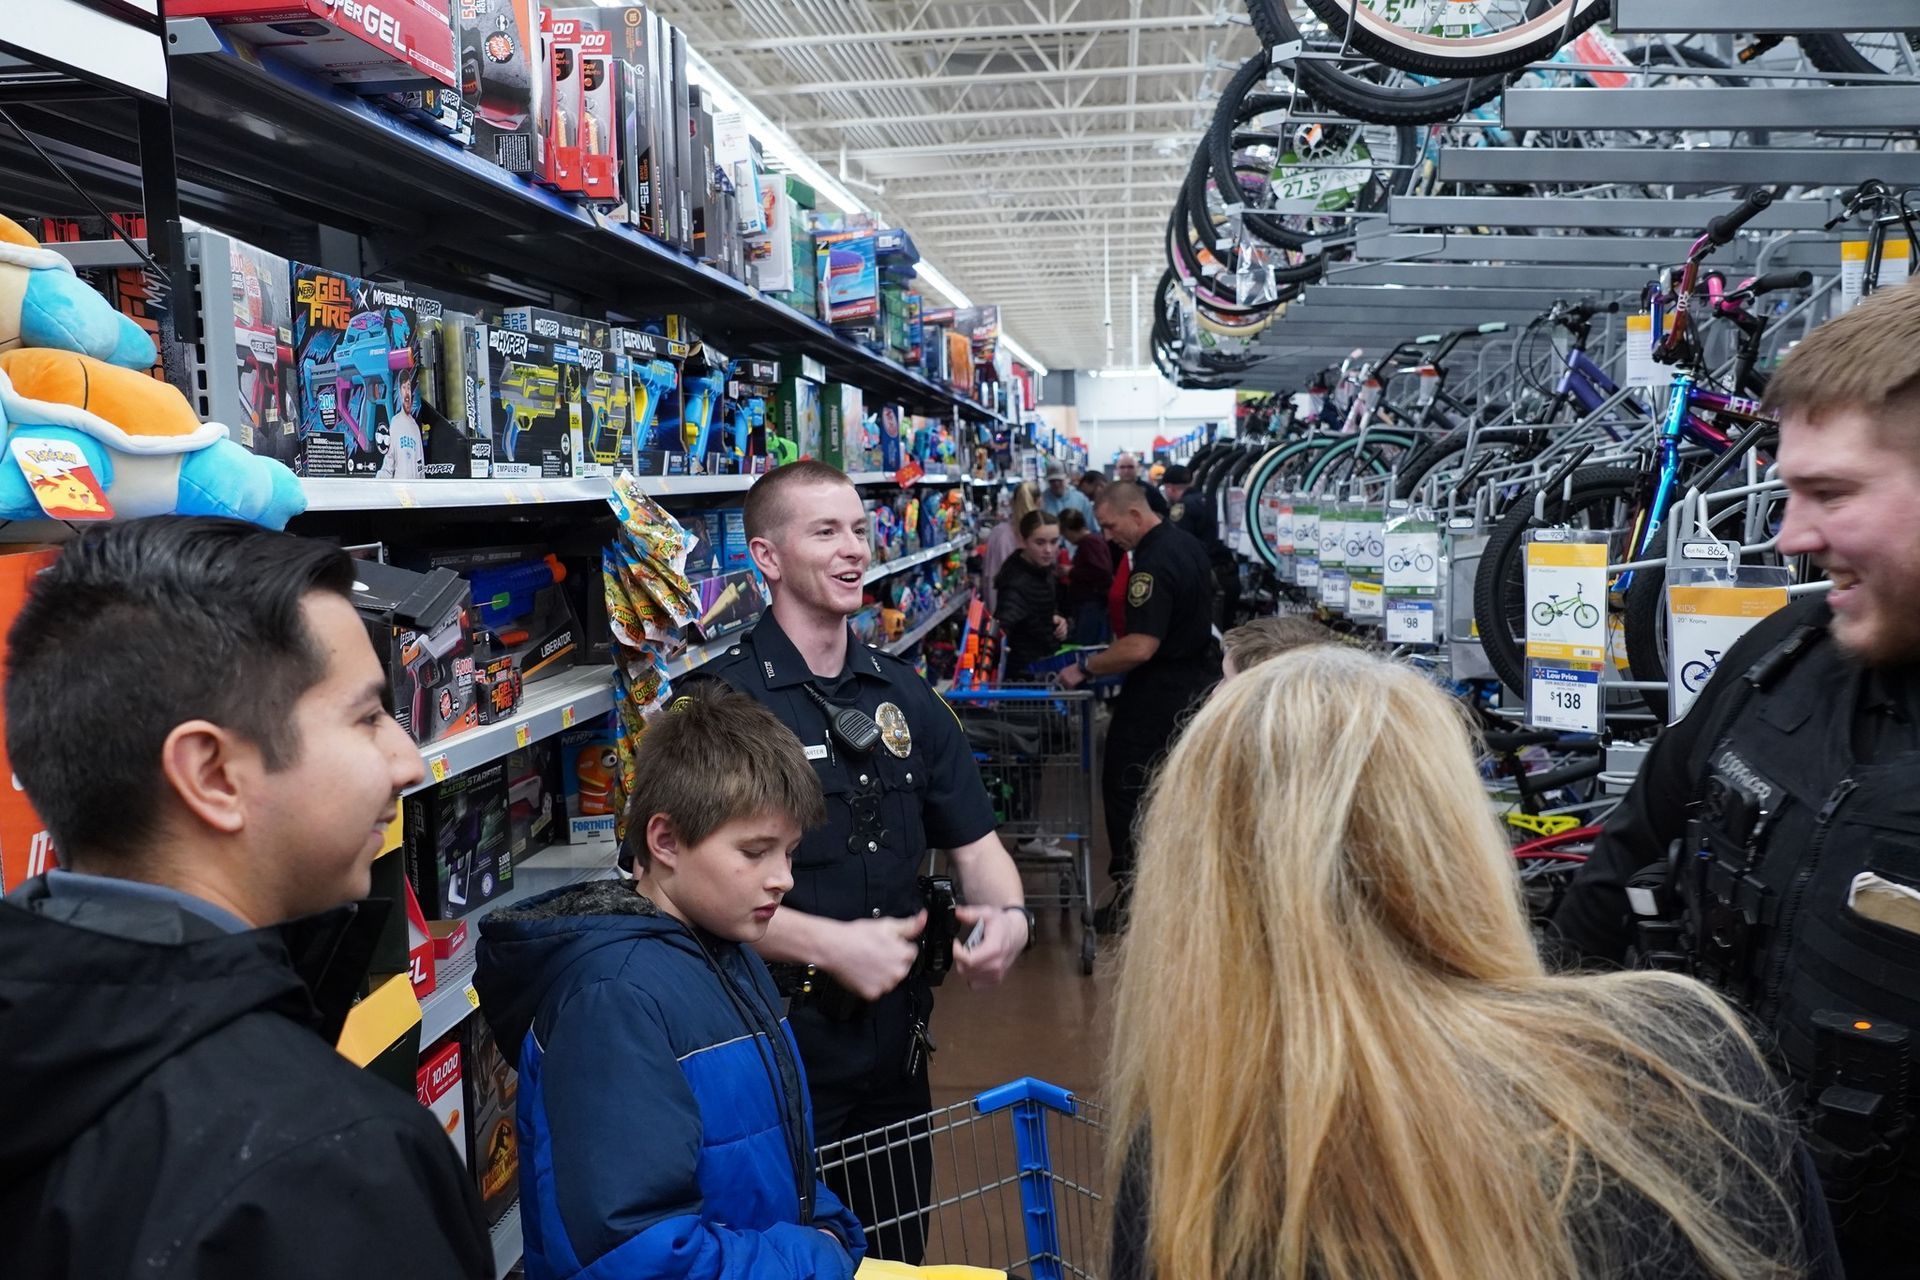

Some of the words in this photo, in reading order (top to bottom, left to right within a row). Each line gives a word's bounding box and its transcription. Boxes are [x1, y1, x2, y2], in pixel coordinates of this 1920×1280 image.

[363, 4, 407, 53] GEL
[1283, 174, 1327, 198] 27.5"
[315, 275, 350, 303] GEL
[497, 330, 529, 359] HYPER
[581, 348, 604, 372] HYPER
[541, 631, 572, 658] LIBERATOR
[1561, 673, 1578, 681] Price
[1550, 691, 1581, 710] $138
[572, 818, 614, 833] FORTNITE
[432, 1052, 459, 1086] 10,000
